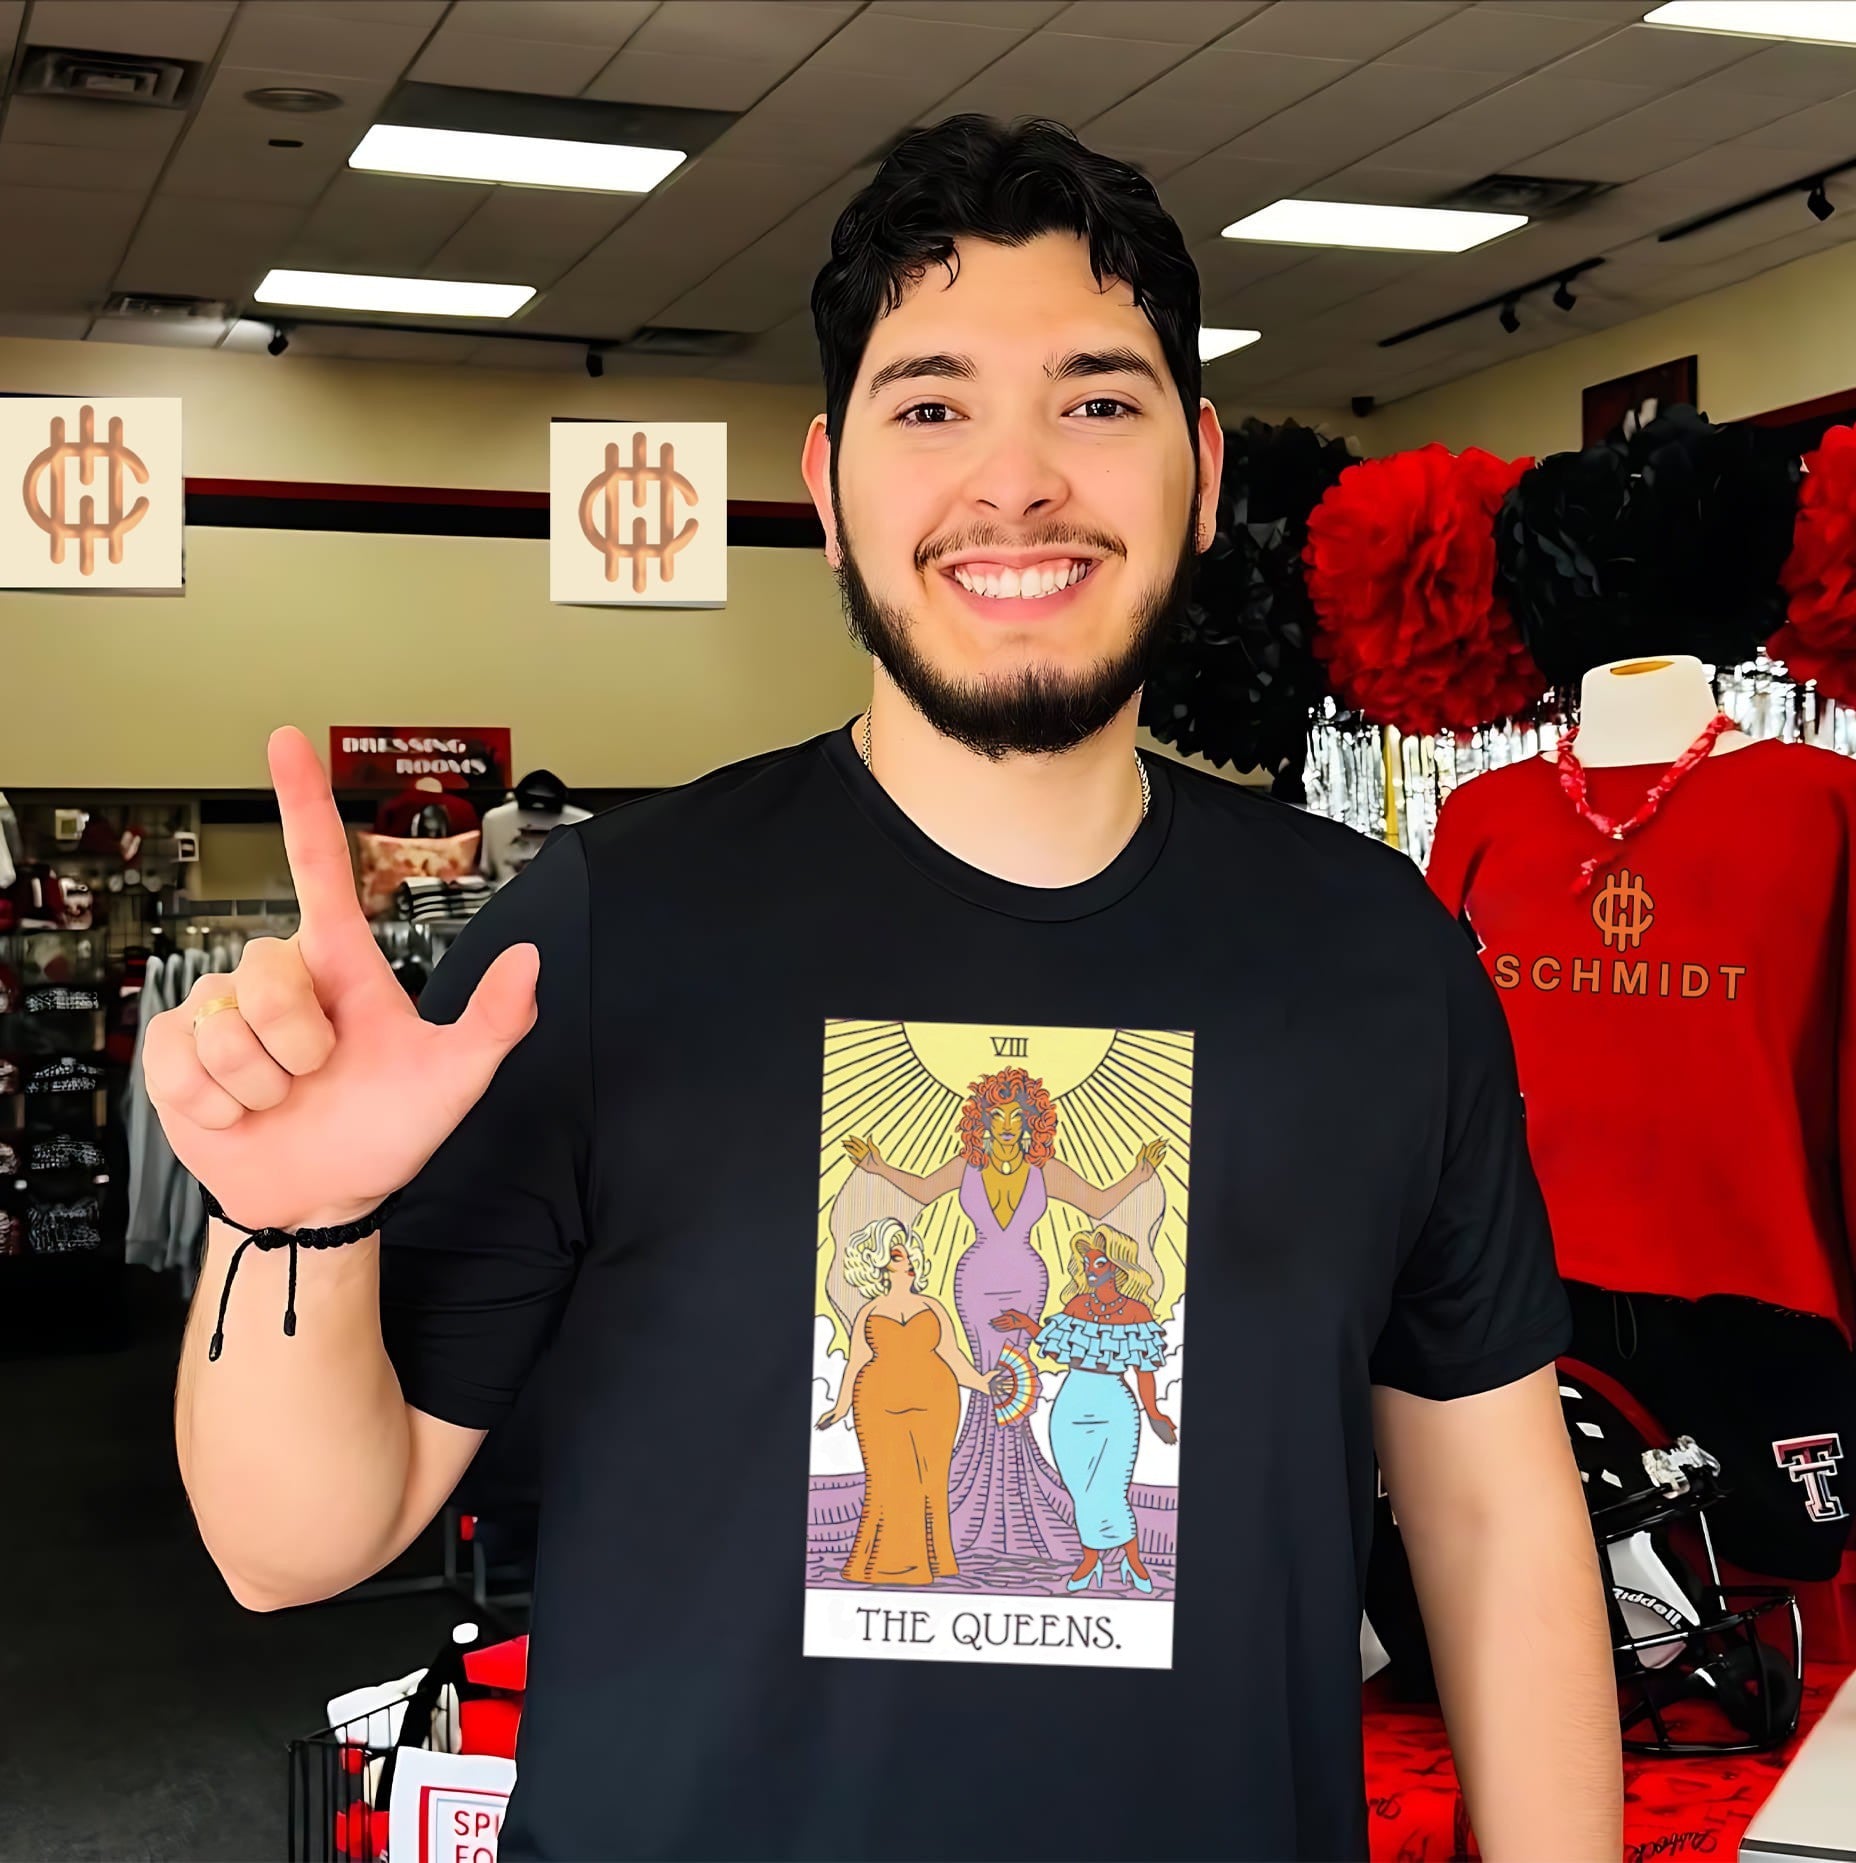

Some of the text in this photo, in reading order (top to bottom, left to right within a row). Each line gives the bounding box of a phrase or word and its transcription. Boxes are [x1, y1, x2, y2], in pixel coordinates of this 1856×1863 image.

[342, 737, 467, 754] DRESSING
[396, 758, 487, 775] ROOMS
[1494, 953, 1746, 1000] SCHMIDT
[990, 1036, 1029, 1057] VIII
[856, 1606, 1122, 1650] THE QUEENS.
